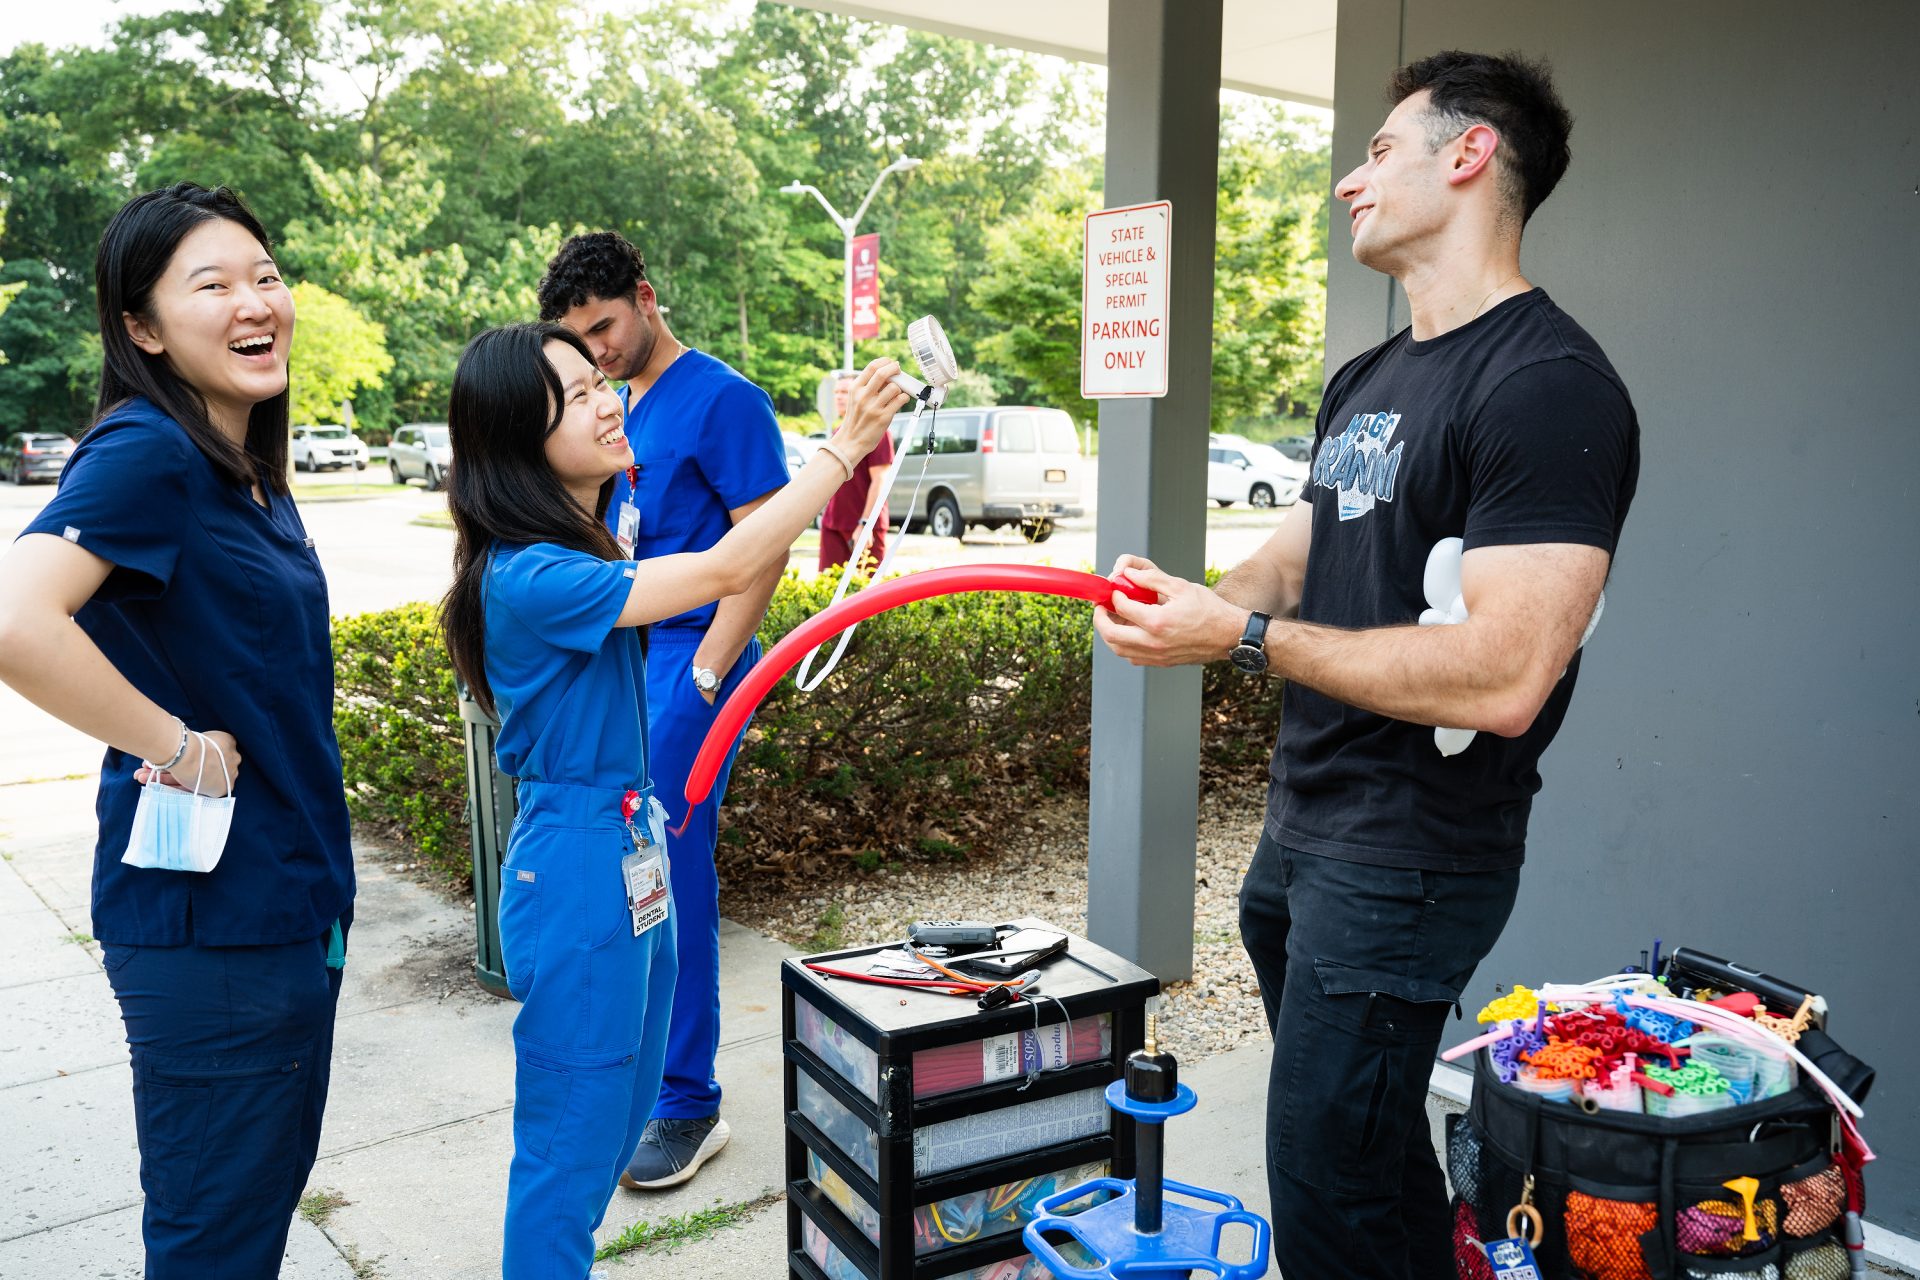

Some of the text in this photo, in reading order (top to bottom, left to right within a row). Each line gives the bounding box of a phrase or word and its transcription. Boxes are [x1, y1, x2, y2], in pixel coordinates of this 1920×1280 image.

[1111, 226, 1145, 243] STATE
[1099, 246, 1156, 266] VEHICLE &
[1105, 271, 1149, 288] SPECIAL
[1106, 293, 1147, 309] PERMIT
[1092, 318, 1160, 340] PARKING
[1104, 350, 1146, 370] ONLY
[636, 911, 665, 932] STUDENT
[638, 906, 662, 924] DENTAL
[1024, 1031, 1035, 1061] 260S
